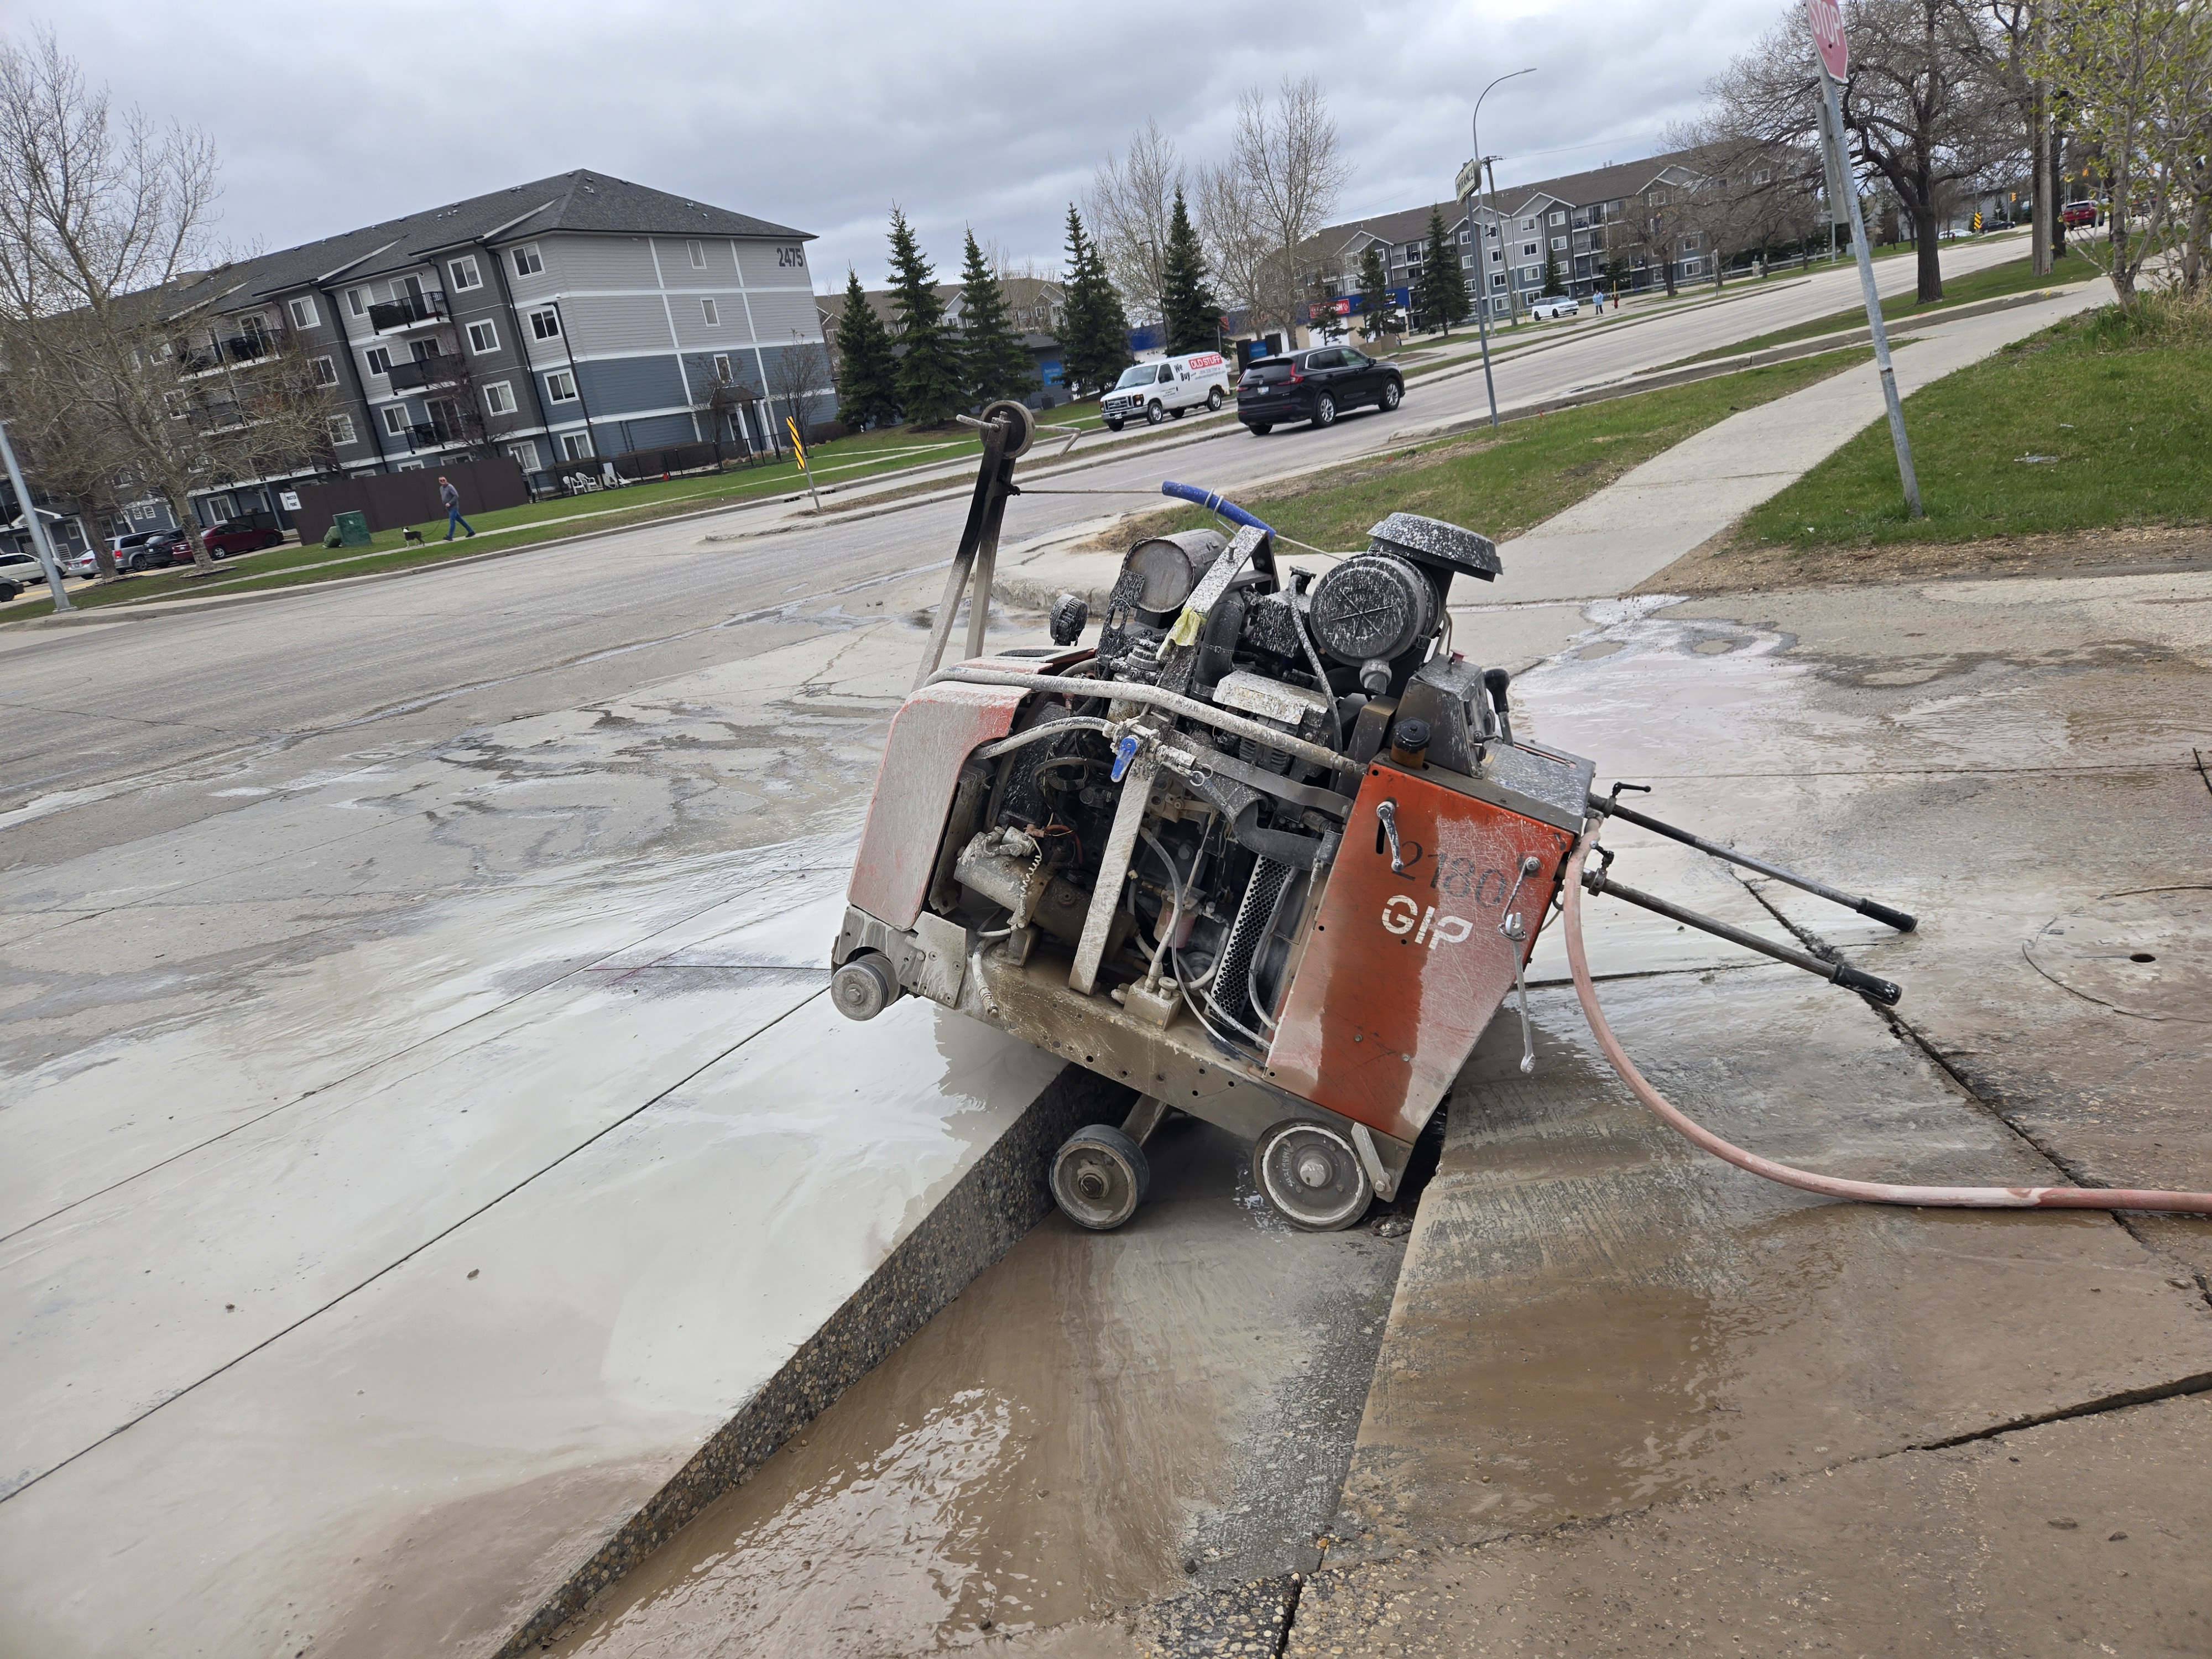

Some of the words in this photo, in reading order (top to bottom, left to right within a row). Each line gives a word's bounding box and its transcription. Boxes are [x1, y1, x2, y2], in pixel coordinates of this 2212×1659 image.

[1808, 0, 1840, 46] STOP
[1456, 166, 1474, 195] ENTRANCE
[776, 247, 804, 267] 2475
[1174, 363, 1183, 373] We
[1190, 359, 1203, 368] OLD
[1203, 355, 1220, 366] STUFF
[1392, 841, 1506, 907] 2180
[1381, 894, 1474, 950] GIP
